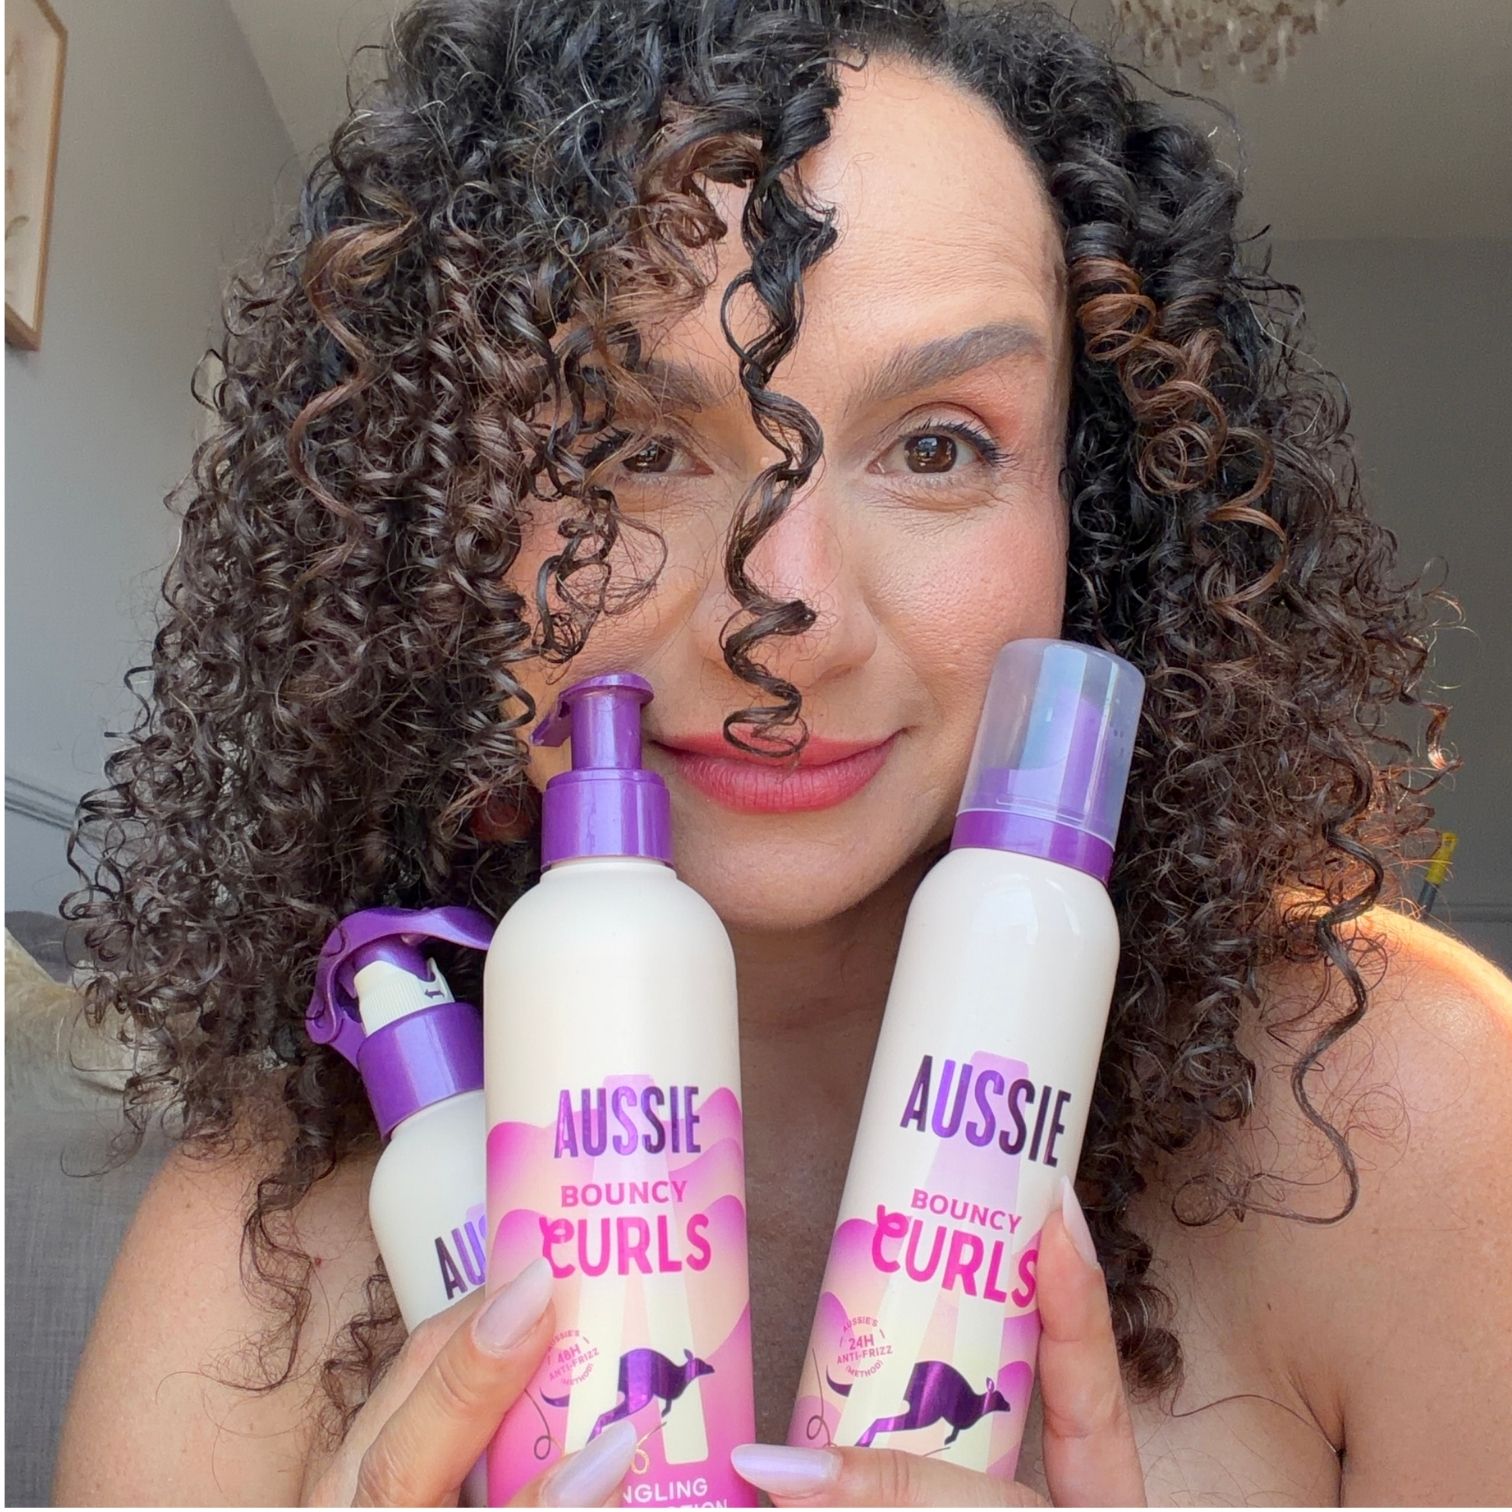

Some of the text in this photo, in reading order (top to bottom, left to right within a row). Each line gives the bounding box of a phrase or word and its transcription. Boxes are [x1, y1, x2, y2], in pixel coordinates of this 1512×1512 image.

[554, 1086, 701, 1159] AUSSIE
[900, 1055, 1072, 1167] AUSSIE
[561, 1180, 687, 1207] BOUNCY
[912, 1189, 1022, 1234] BOUNCY
[539, 1213, 712, 1279] CURLS
[872, 1205, 1039, 1308] CURLS
[837, 1345, 893, 1364] ANTI-FRIZZ
[848, 1334, 874, 1350] 24H
[623, 1478, 707, 1503] NGLING
